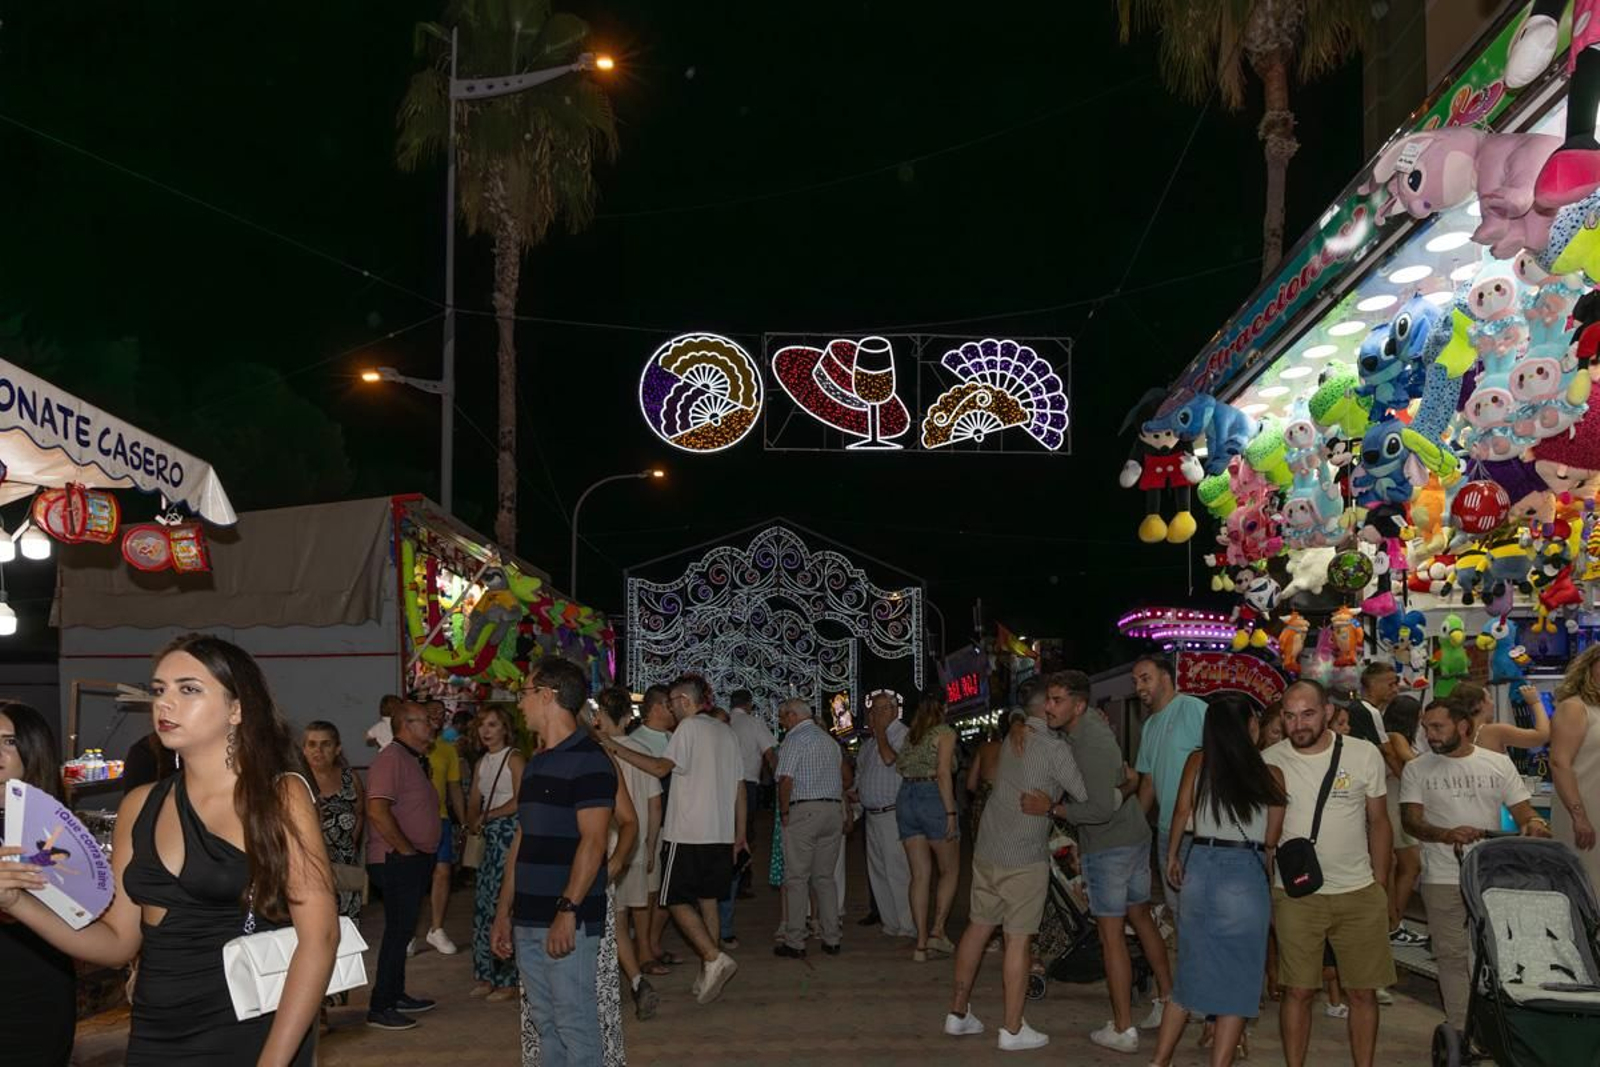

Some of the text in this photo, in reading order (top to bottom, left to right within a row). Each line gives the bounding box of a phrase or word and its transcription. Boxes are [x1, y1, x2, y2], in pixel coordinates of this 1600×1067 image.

[1194, 204, 1367, 389] Atraccion
[97, 427, 184, 488] CASERO
[80, 833, 101, 859] corra
